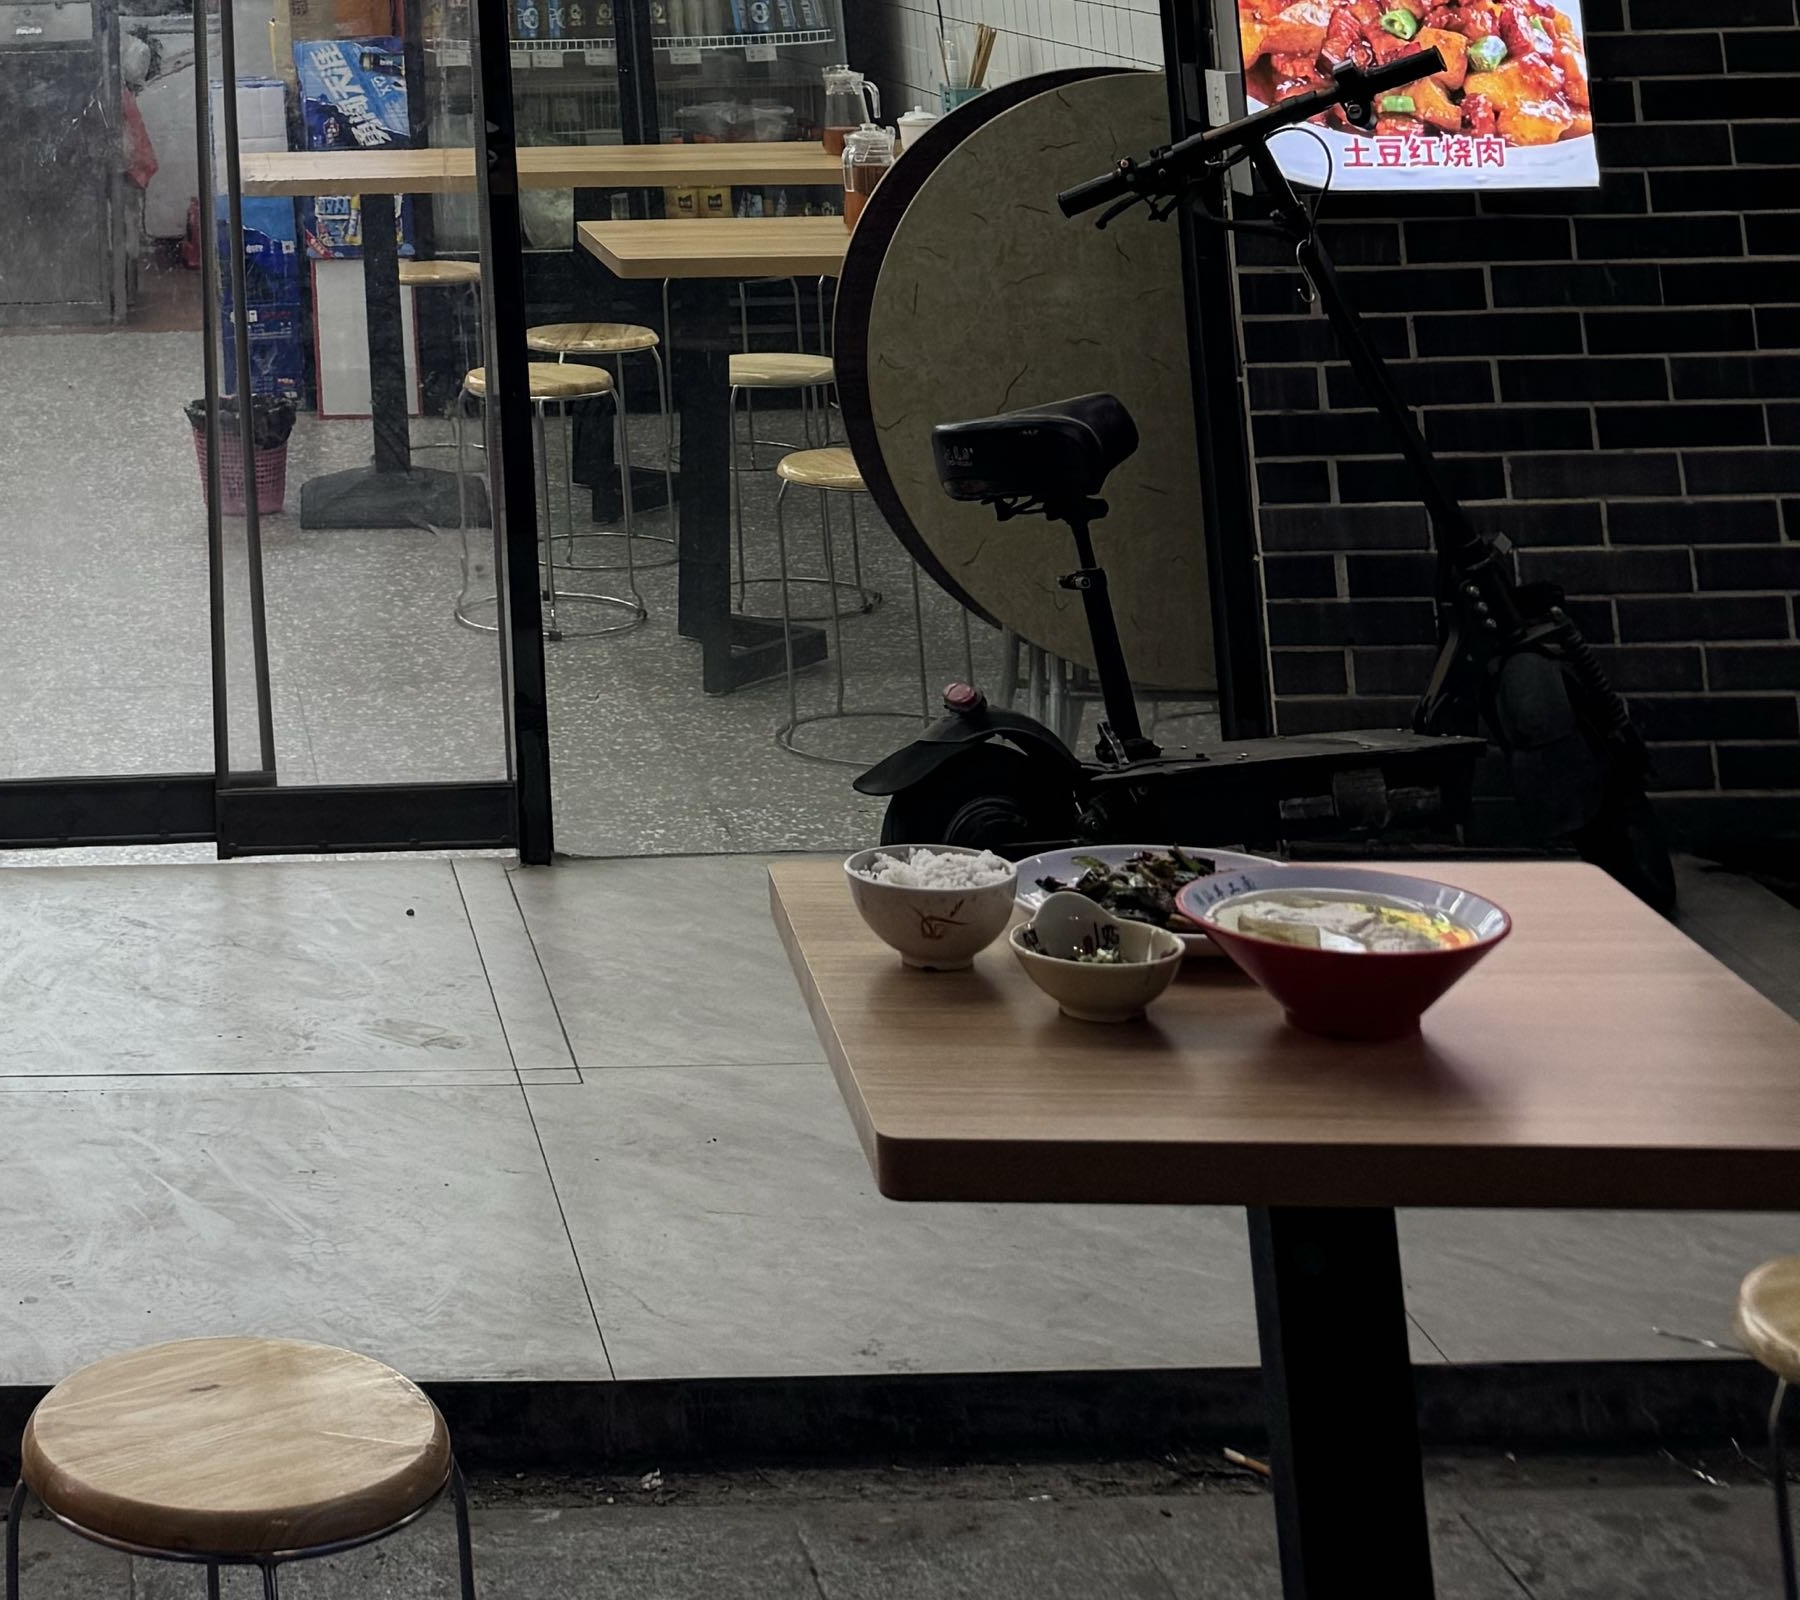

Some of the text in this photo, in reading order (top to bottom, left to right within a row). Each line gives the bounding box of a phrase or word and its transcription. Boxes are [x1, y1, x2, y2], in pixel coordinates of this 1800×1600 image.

[1343, 135, 1507, 169] 土豆红烧肉
